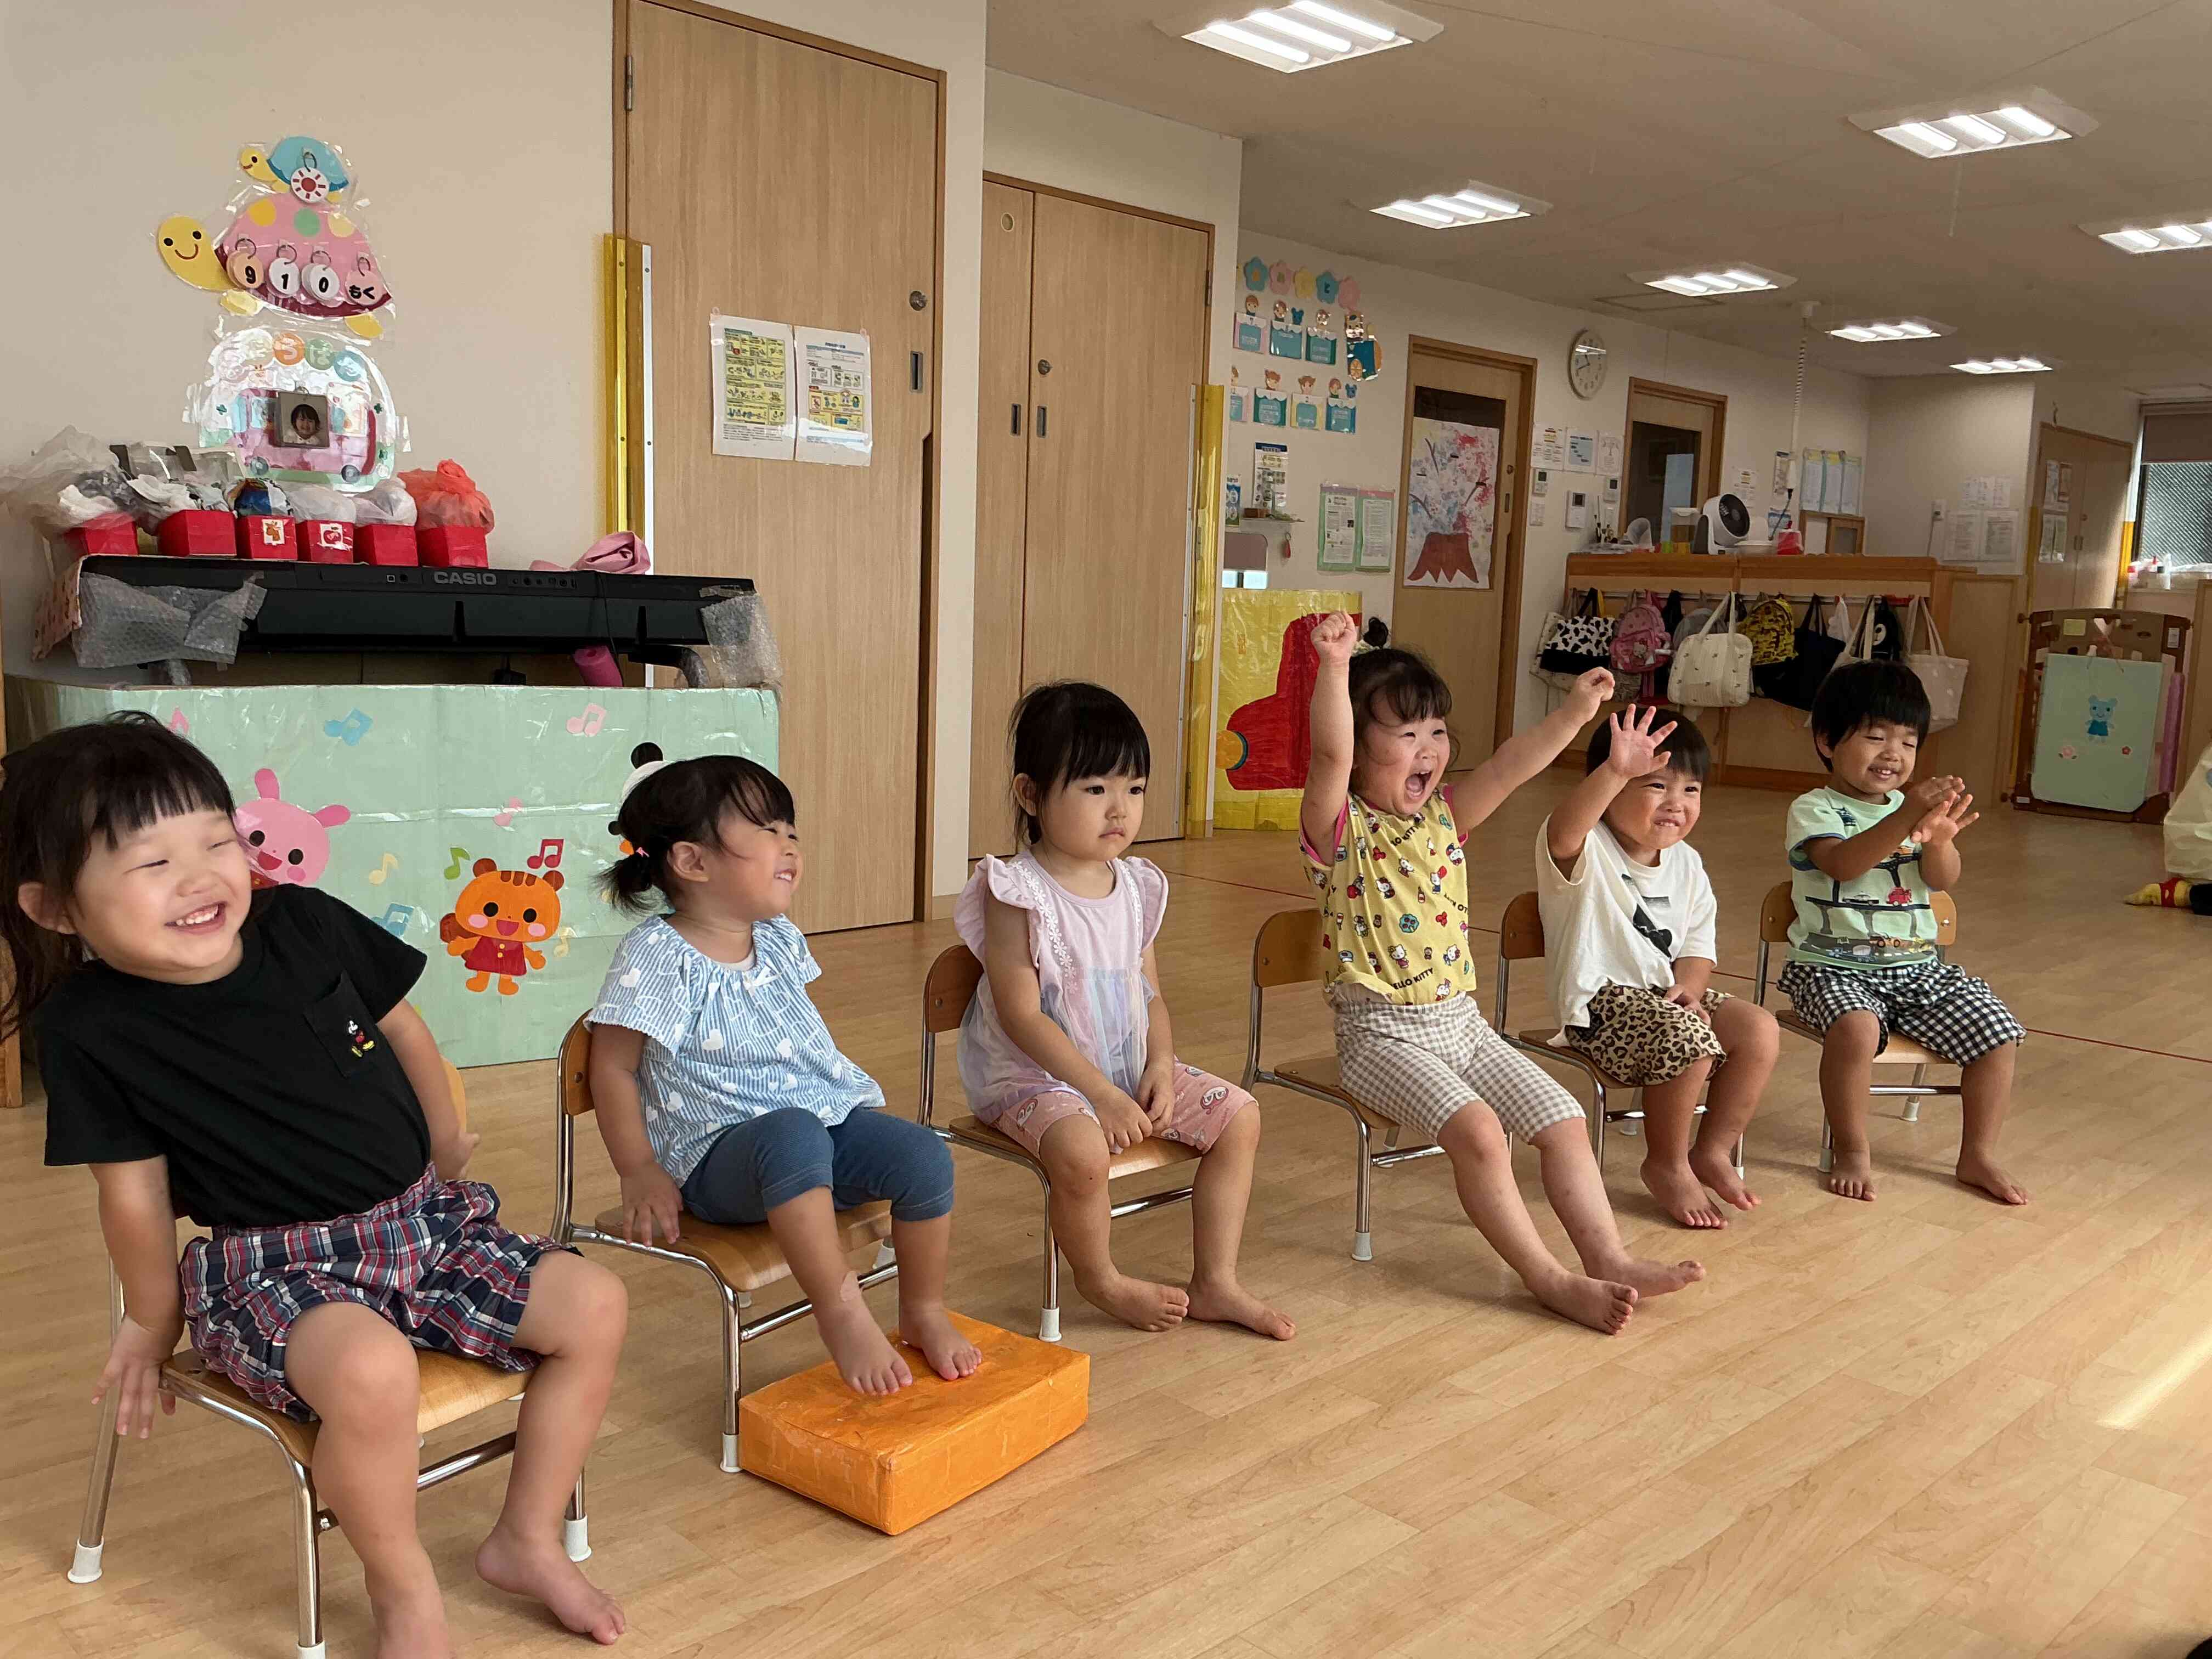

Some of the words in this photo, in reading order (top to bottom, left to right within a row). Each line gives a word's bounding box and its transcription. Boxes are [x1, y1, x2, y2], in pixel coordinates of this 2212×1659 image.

[348, 284, 375, 300] もく
[433, 571, 497, 585] CASIO
[1390, 978, 1413, 990] ELLO
[1413, 967, 1433, 983] KITTY
